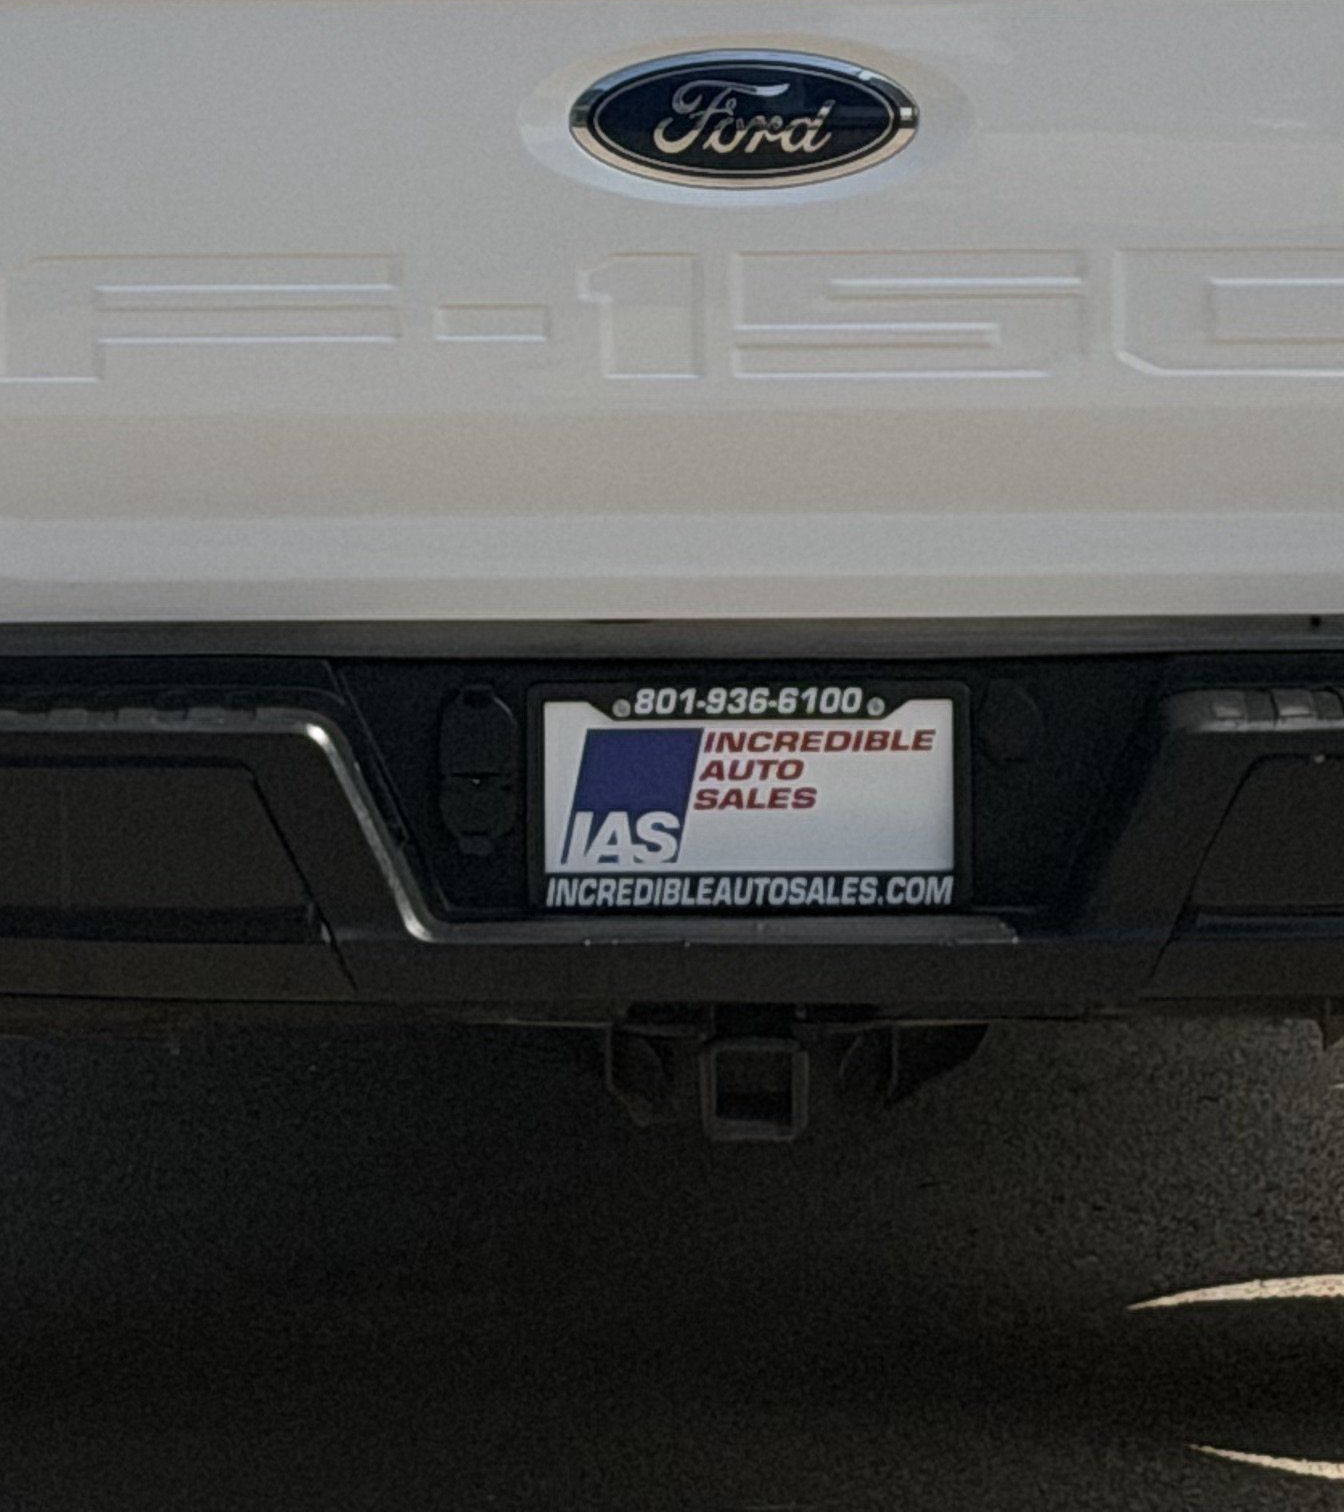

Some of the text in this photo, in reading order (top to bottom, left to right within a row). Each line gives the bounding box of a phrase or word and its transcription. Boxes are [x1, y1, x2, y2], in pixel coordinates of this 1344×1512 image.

[653, 79, 836, 154] Ford
[635, 688, 862, 715] 801-936-6100
[704, 729, 937, 753] INCREDIBLE
[699, 759, 806, 782] AUTO
[693, 787, 819, 811] SALES
[567, 811, 680, 864] IAS
[546, 876, 954, 908] INCREDIBLEAUTOSALES.COM
